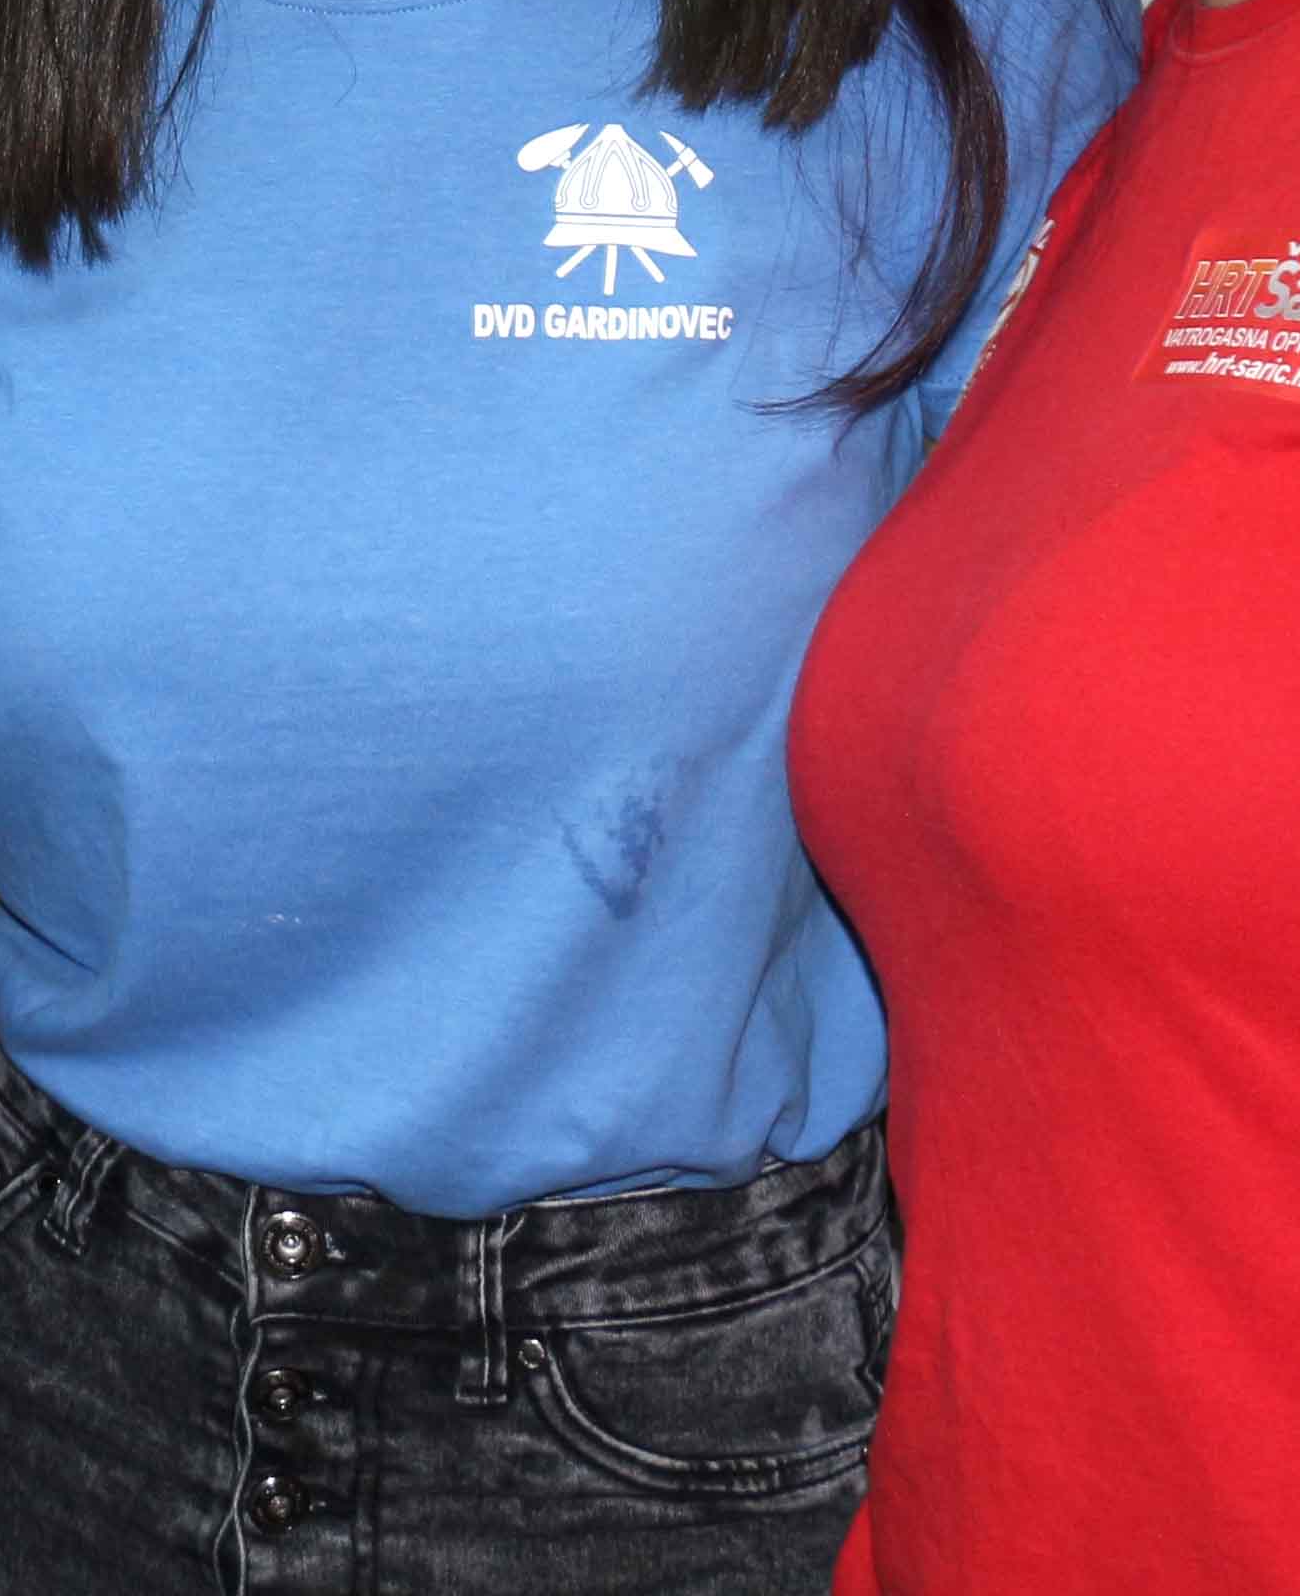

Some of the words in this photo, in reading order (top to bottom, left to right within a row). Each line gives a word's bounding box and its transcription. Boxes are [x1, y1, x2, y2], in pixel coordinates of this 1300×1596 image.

[473, 304, 536, 338] DVD
[544, 304, 734, 340] GARDINOVEC
[1162, 326, 1269, 349] VATROGASNA
